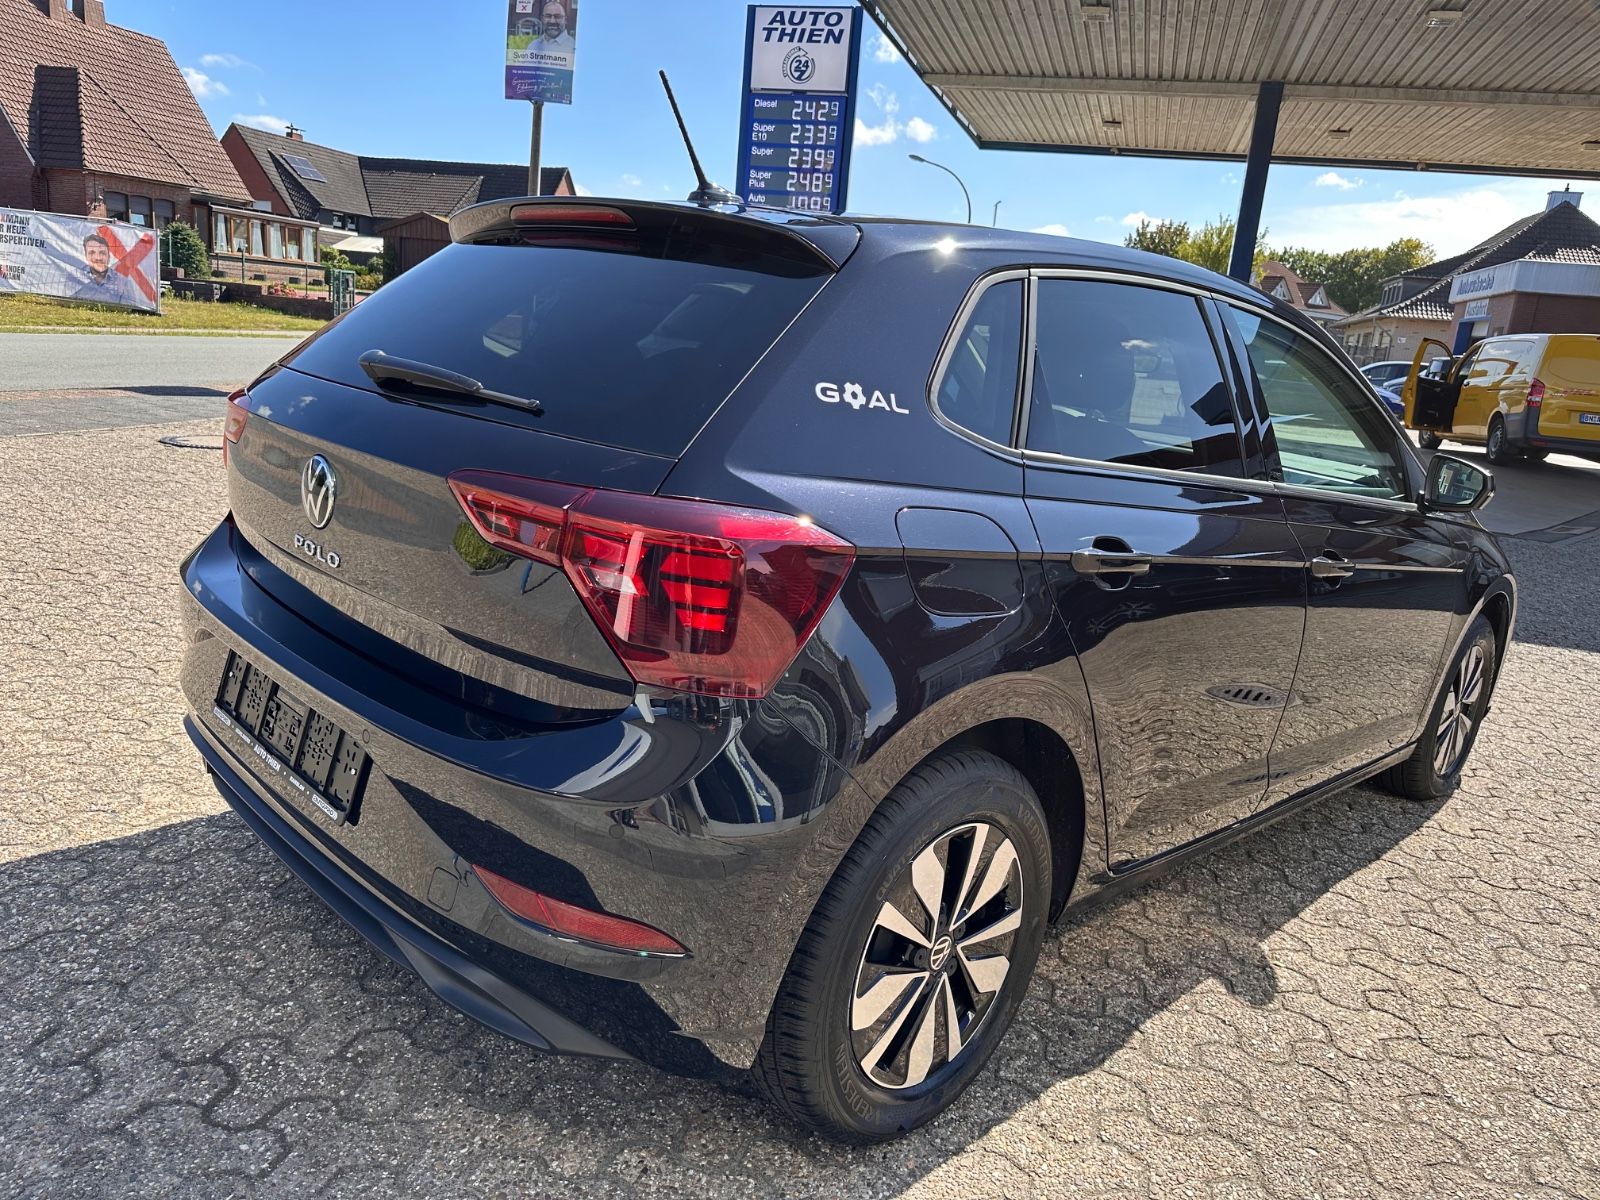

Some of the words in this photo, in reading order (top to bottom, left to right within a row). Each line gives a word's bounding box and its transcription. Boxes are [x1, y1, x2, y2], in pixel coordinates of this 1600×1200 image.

[767, 10, 844, 27] AUTO
[762, 27, 845, 44] THIEN
[513, 51, 528, 59] Sven
[529, 52, 567, 62] Stratmann
[794, 59, 810, 70] 24
[754, 98, 778, 108] Diesel
[791, 100, 839, 121] 2429
[752, 122, 775, 134] Super
[790, 123, 837, 145] 2339
[752, 132, 768, 141] E10
[751, 146, 774, 157] Super
[788, 147, 835, 169] 2399
[748, 179, 765, 189] Plus
[750, 169, 772, 180] Super
[786, 171, 833, 192] 2489
[748, 193, 766, 203] Auto
[7, 224, 26, 235] NEUE
[295, 534, 340, 568] POLO
[253, 744, 267, 759] AUTO
[265, 753, 281, 771] THIEN
[1018, 803, 1049, 889] VREDESTEIN
[836, 1043, 881, 1125] VREDESTEIN
